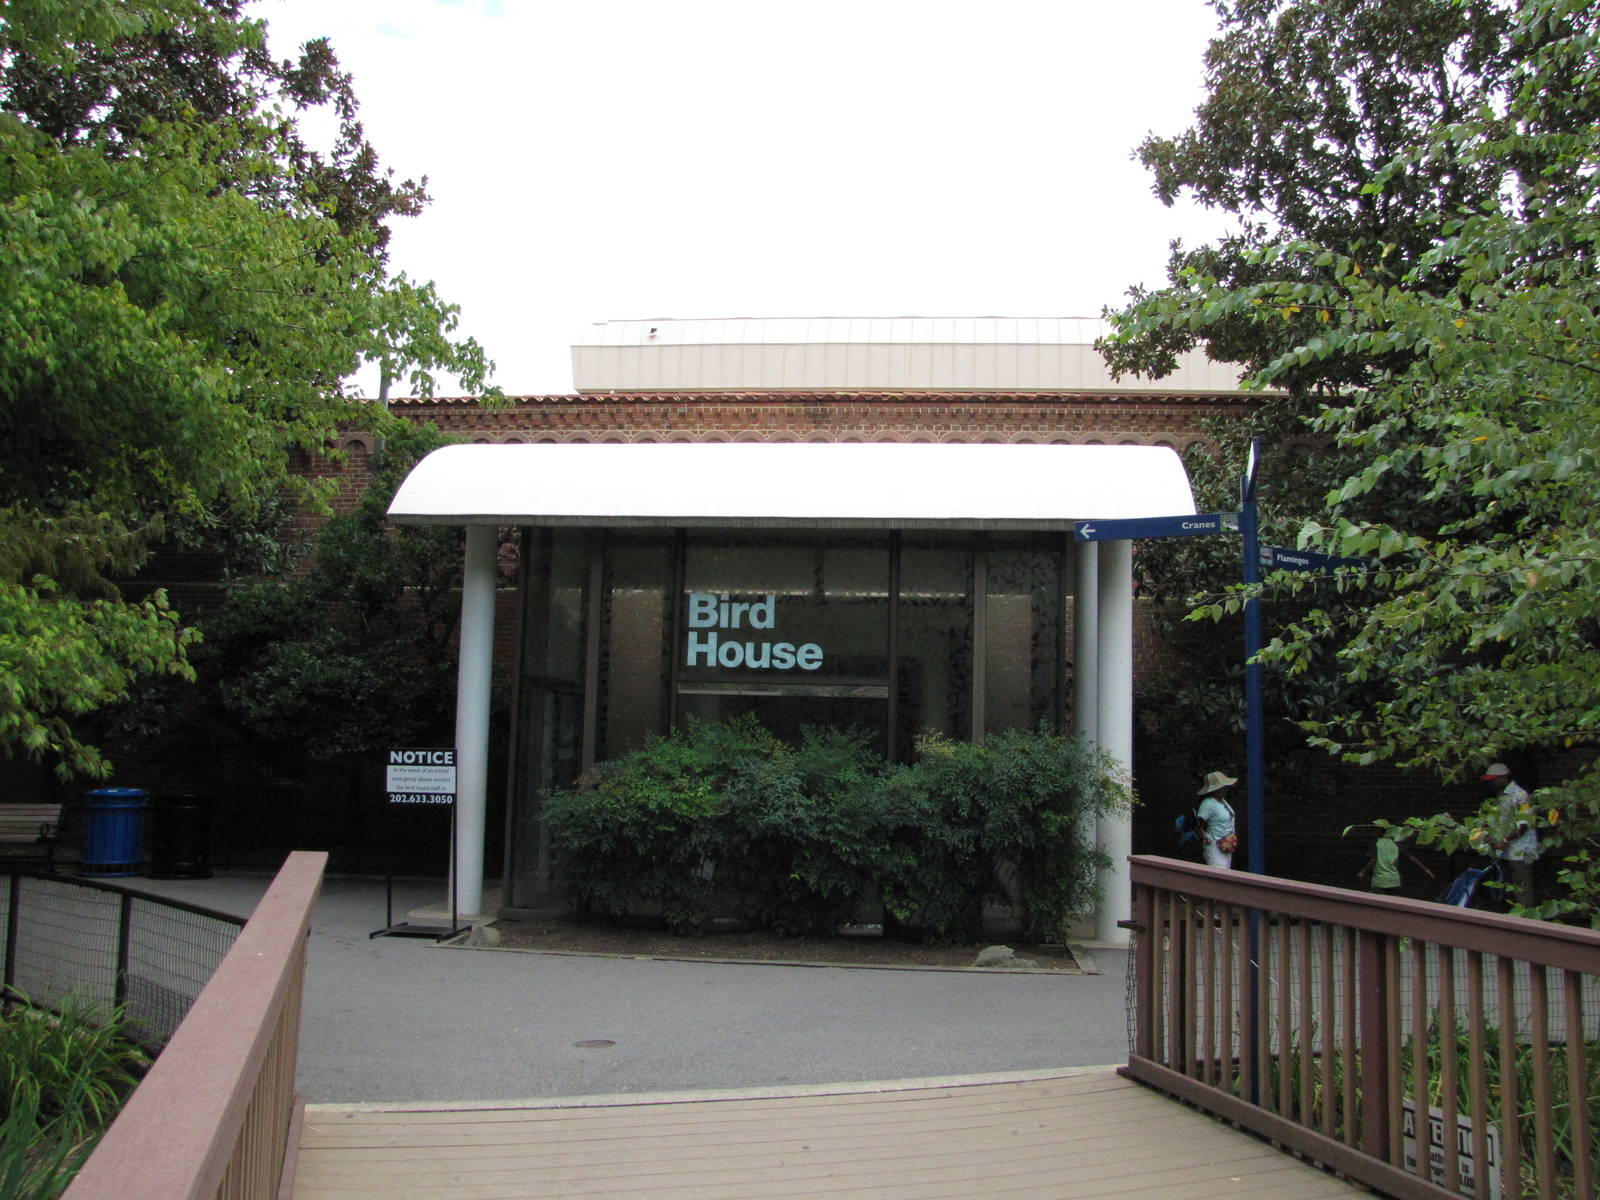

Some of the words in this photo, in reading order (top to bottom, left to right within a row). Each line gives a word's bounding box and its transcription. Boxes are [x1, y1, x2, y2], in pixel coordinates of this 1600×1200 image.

[1182, 521, 1216, 530] Cranes
[1276, 554, 1309, 566] Flamingos
[688, 592, 776, 630] Bird
[687, 631, 824, 671] House
[390, 751, 453, 764] NOTICE
[390, 794, 453, 804] 202.633.3050
